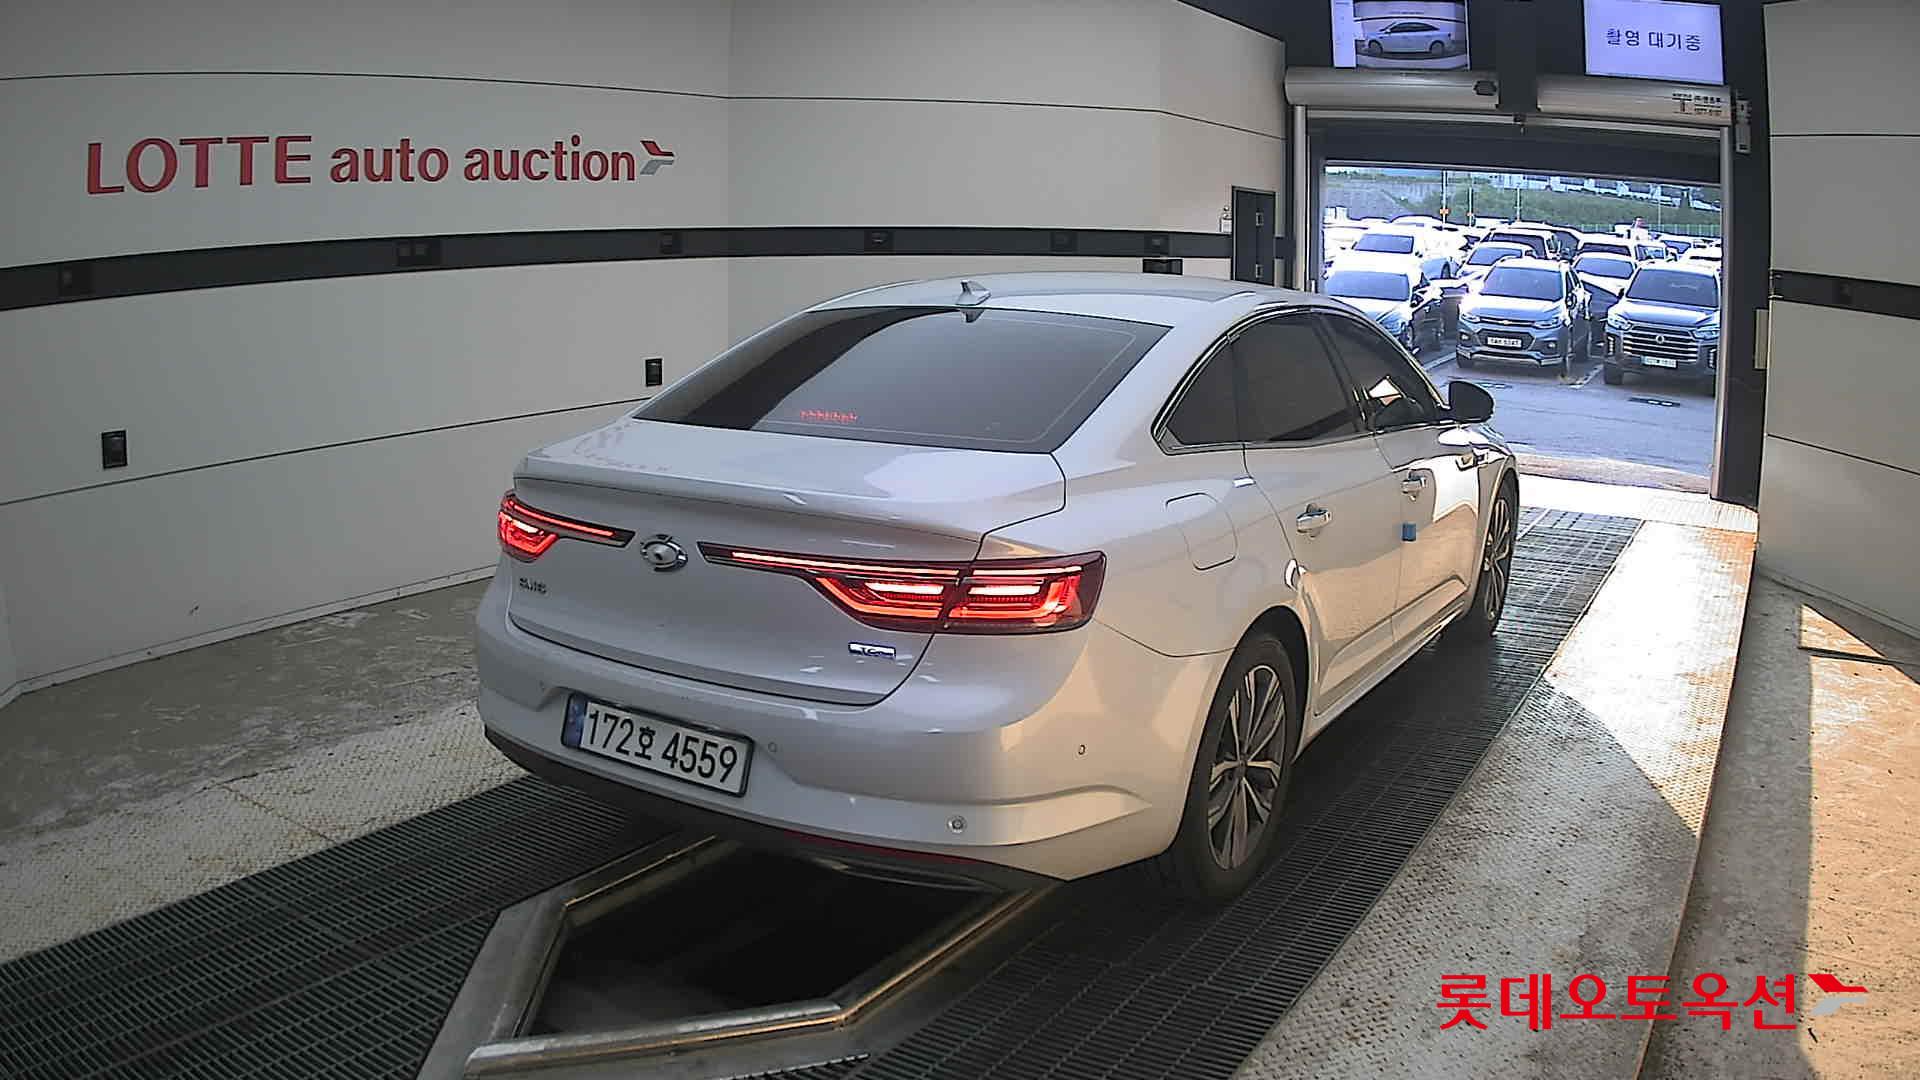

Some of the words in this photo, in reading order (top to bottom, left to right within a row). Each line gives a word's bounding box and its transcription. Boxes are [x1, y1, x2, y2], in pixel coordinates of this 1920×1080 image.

[1647, 31, 1702, 52] 대기중
[86, 135, 312, 194] LOTTE
[328, 137, 449, 183] auto
[463, 134, 637, 182] auction
[588, 710, 656, 761] 172호
[661, 731, 738, 783] 4559
